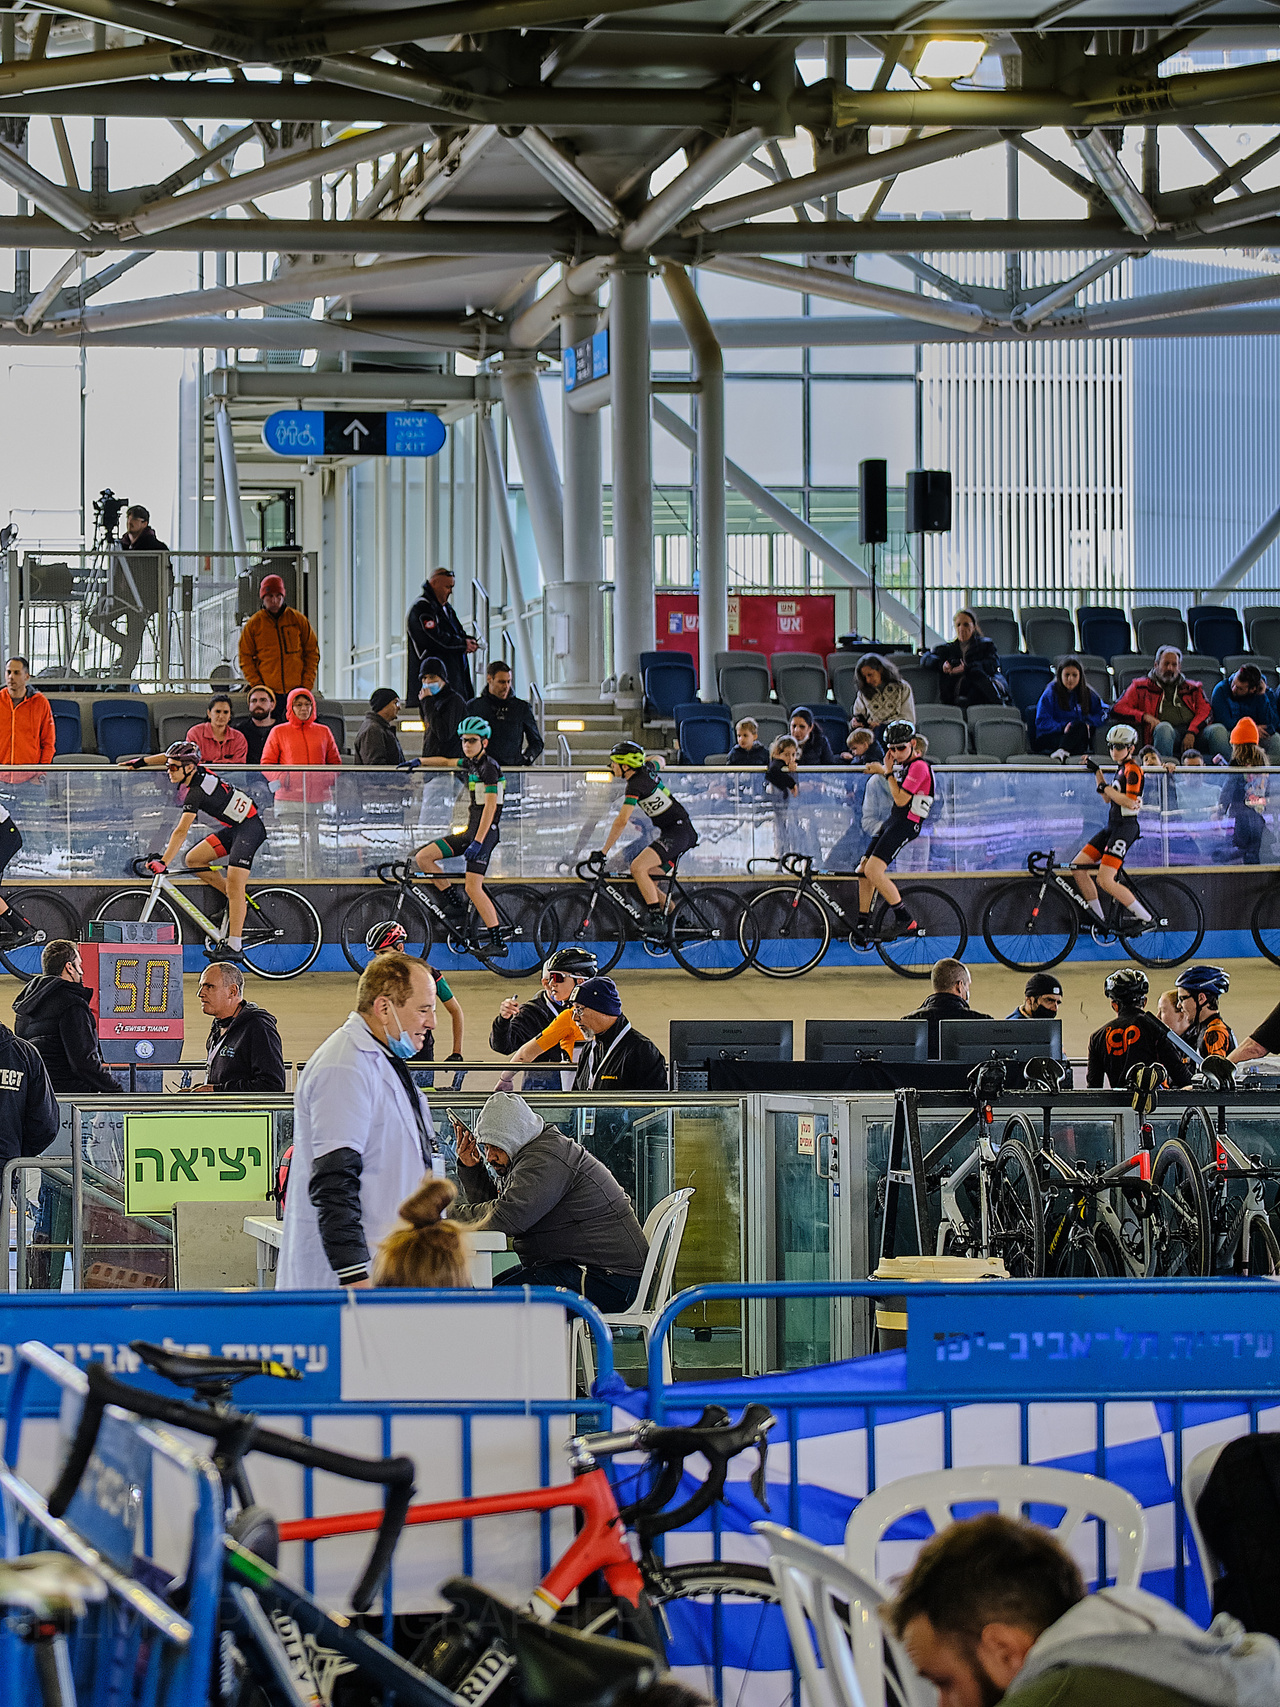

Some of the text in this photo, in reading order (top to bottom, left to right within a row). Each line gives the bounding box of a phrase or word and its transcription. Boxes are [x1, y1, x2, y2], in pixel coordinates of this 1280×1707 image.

[394, 416, 428, 427] יציאה
[395, 442, 426, 452] EXIT
[779, 618, 801, 631] אש
[233, 797, 247, 813] 15
[648, 796, 665, 811] 28
[170, 888, 215, 930] MERIDA
[411, 886, 446, 919] DOLAN
[606, 885, 641, 919] DOLAN
[811, 882, 845, 917] DOLAN
[1055, 876, 1090, 910] DOLAN
[113, 959, 170, 1013] 50
[124, 1025, 170, 1033] SWISS TIMING
[135, 1147, 261, 1182] יציאה
